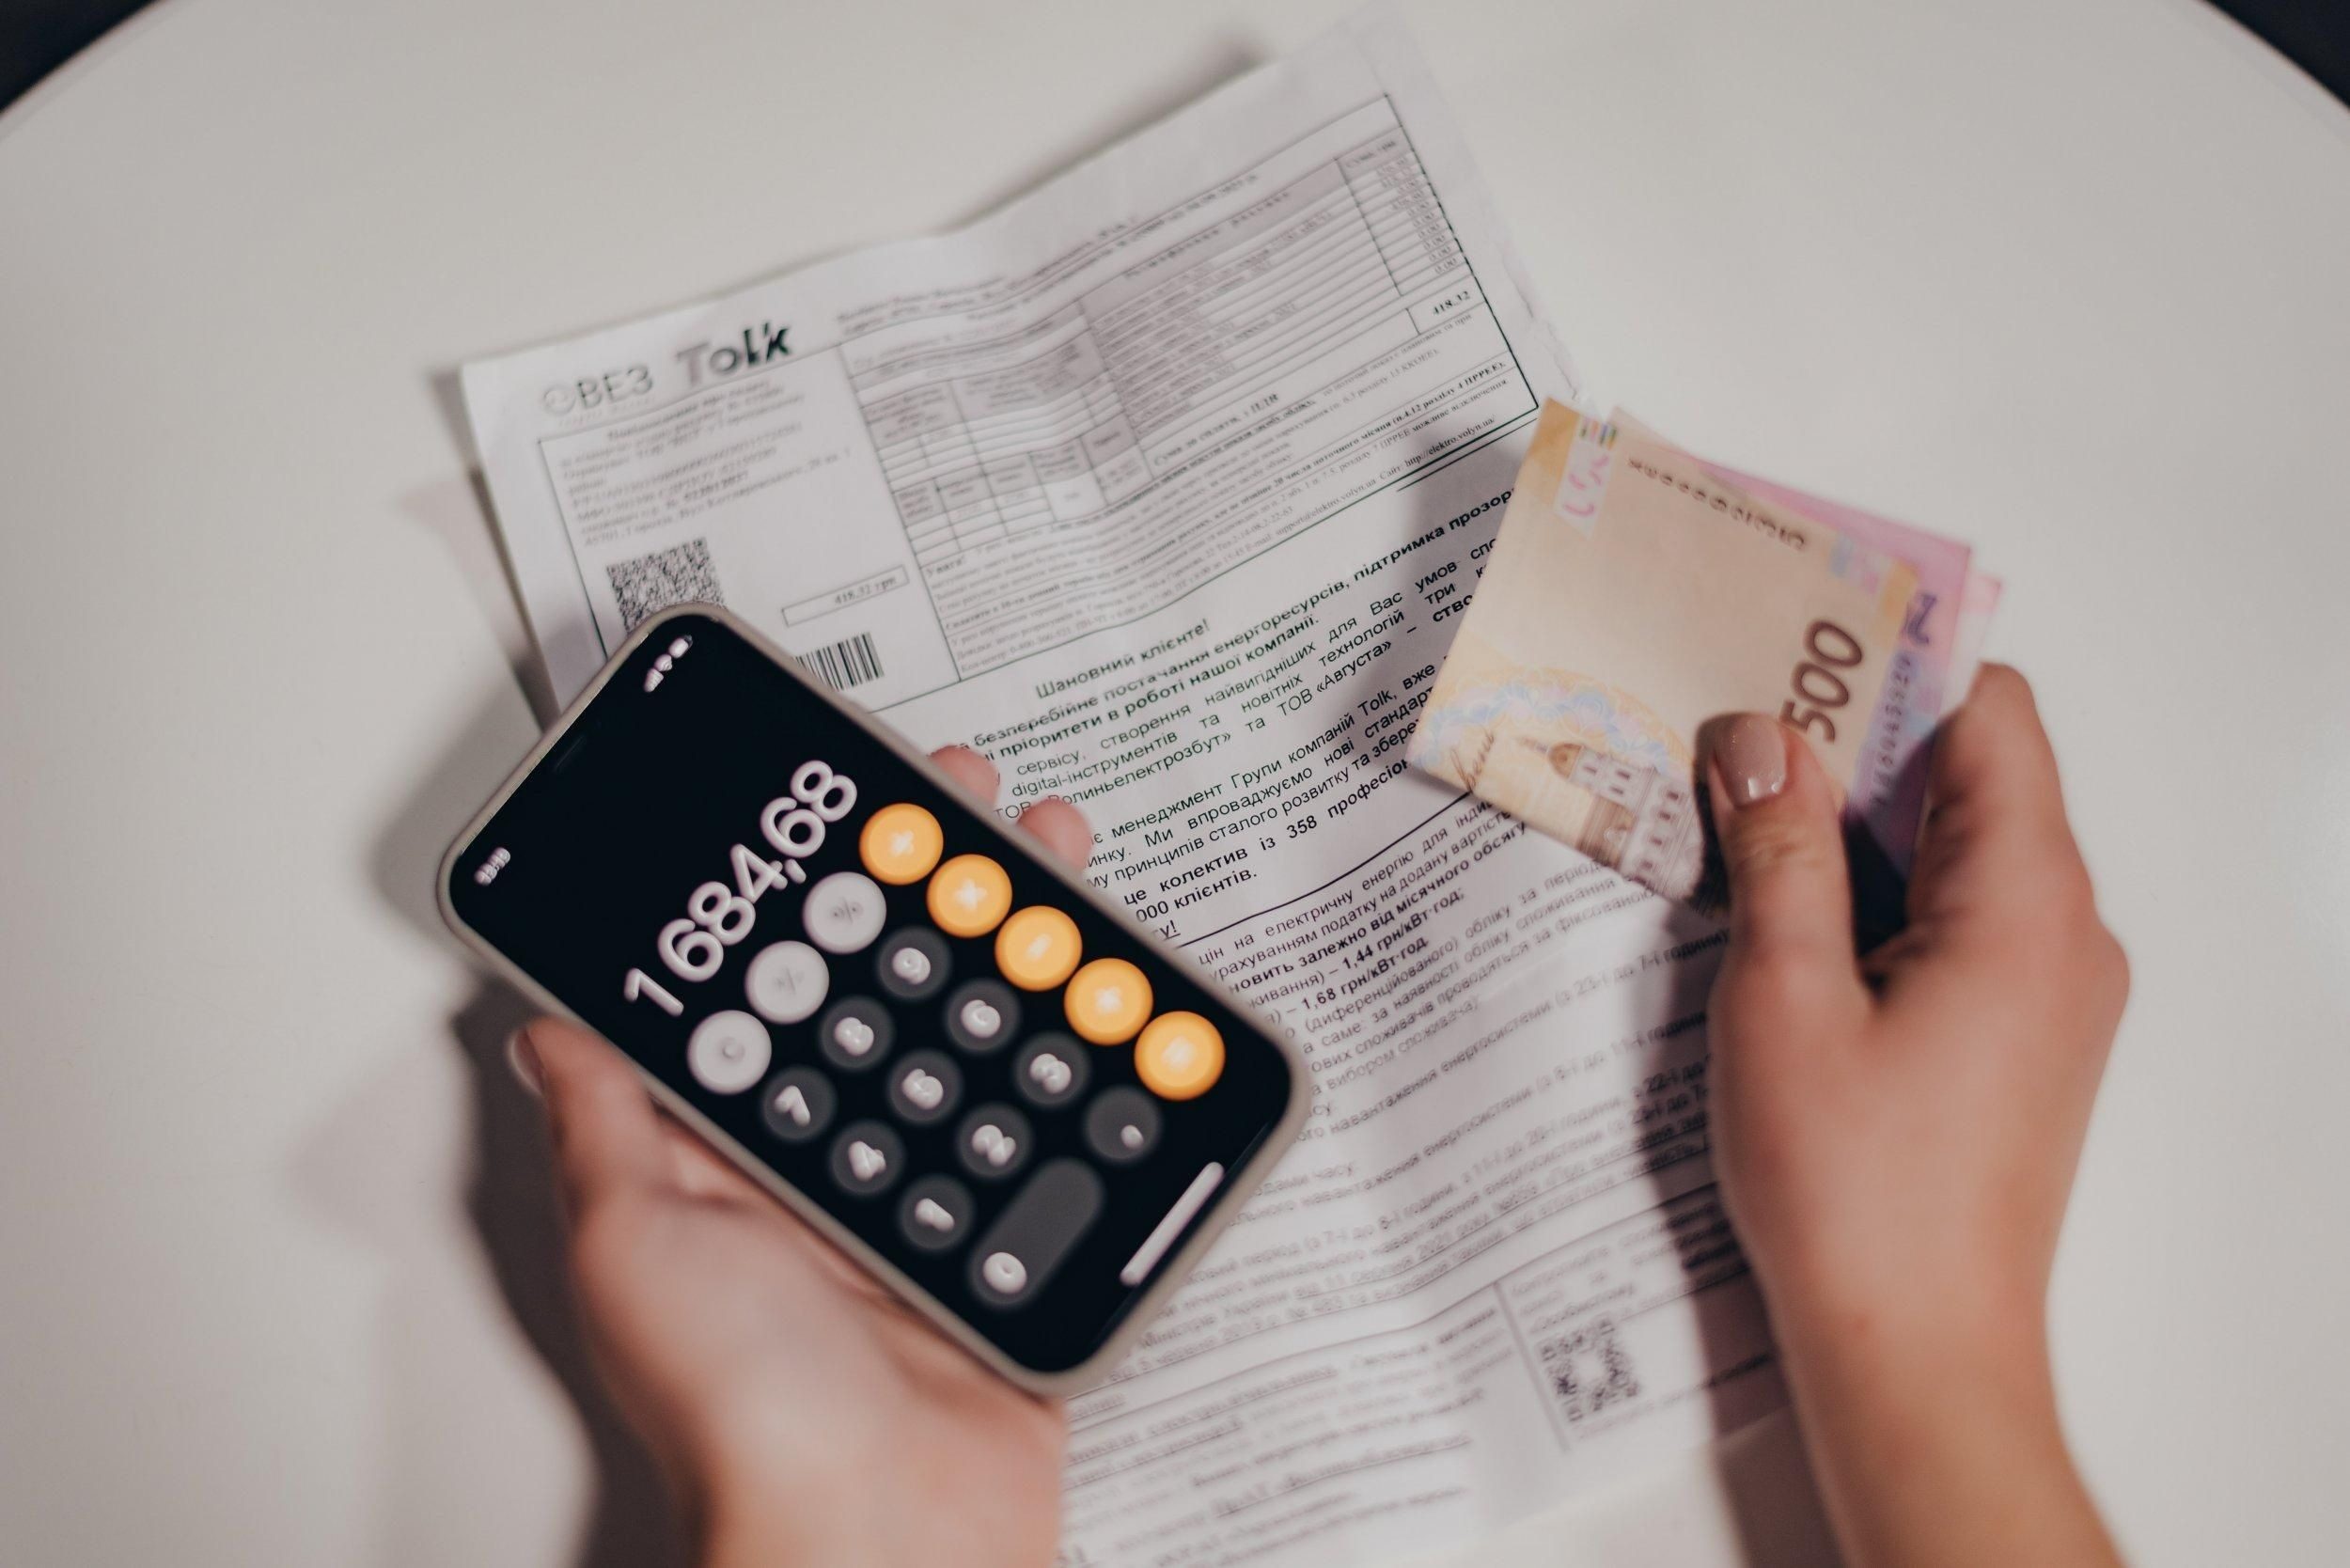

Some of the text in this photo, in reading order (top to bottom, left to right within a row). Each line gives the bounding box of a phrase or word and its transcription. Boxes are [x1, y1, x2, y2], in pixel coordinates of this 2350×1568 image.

[974, 697, 1098, 747] безперебійне
[1104, 650, 1210, 701] постачання
[1214, 580, 1350, 654] енергоресурсів,
[1353, 526, 1445, 582] підтримка
[1447, 485, 1516, 532] прозор
[1016, 750, 1086, 776] сервісу,
[1100, 704, 1191, 749] створення
[1204, 641, 1316, 706] найвигідніших
[1328, 617, 1356, 643] для
[1370, 591, 1402, 616] Вас
[1415, 561, 1457, 593] умов
[1036, 618, 1210, 698] Шановний клієнте!
[999, 614, 1319, 758] пріоритети в роботі нашої компанії.
[1011, 583, 1455, 805] digital-інструментів та новітніх технологій три
[1047, 729, 1232, 808] олиньелектрозбут»
[1246, 717, 1265, 732] та
[1277, 688, 1312, 716] ТОВ
[1316, 640, 1392, 693] «Августа»
[1778, 619, 1863, 743] 500
[1111, 664, 1435, 839] менеджмент Групи компаній Tolk, вже
[1115, 837, 1204, 881] принципів
[1209, 807, 1277, 842] сталого
[1282, 766, 1349, 816] розвитку
[1352, 753, 1371, 771] та
[1371, 716, 1421, 760] збере
[1145, 828, 1173, 847] Ми
[1187, 767, 1312, 830] впроваджуємо
[1324, 737, 1354, 767] нові
[1124, 889, 1147, 905] це
[1160, 848, 1247, 891] колектив
[1260, 837, 1276, 850] із
[1287, 815, 1317, 839] 358
[1173, 869, 1257, 909] клієнтів.
[1198, 797, 1496, 965] цін на електричну енергію для інди
[1298, 927, 1367, 967] залежно
[1370, 910, 1395, 932] від
[1395, 859, 1470, 915] місячного
[1473, 818, 1527, 862] обсягу
[1321, 897, 1376, 935] податку
[1380, 885, 1396, 902] на
[1399, 850, 1449, 892] додану
[1302, 987, 1336, 1010] 1,68
[1305, 939, 1459, 1033] (диференційованого)
[1465, 904, 1511, 939] обліку
[1521, 888, 1536, 903] за
[1343, 944, 1373, 969] 1,44
[1371, 1007, 1388, 1023] за
[1392, 962, 1460, 1011] наявності
[1464, 929, 1510, 964] обліку
[1515, 878, 1615, 930] споживання
[1326, 1048, 1397, 1090] вибором
[1355, 1000, 1434, 1055] споживачів
[774, 1085, 810, 1125] 7
[1330, 1068, 1438, 1134] навантаження
